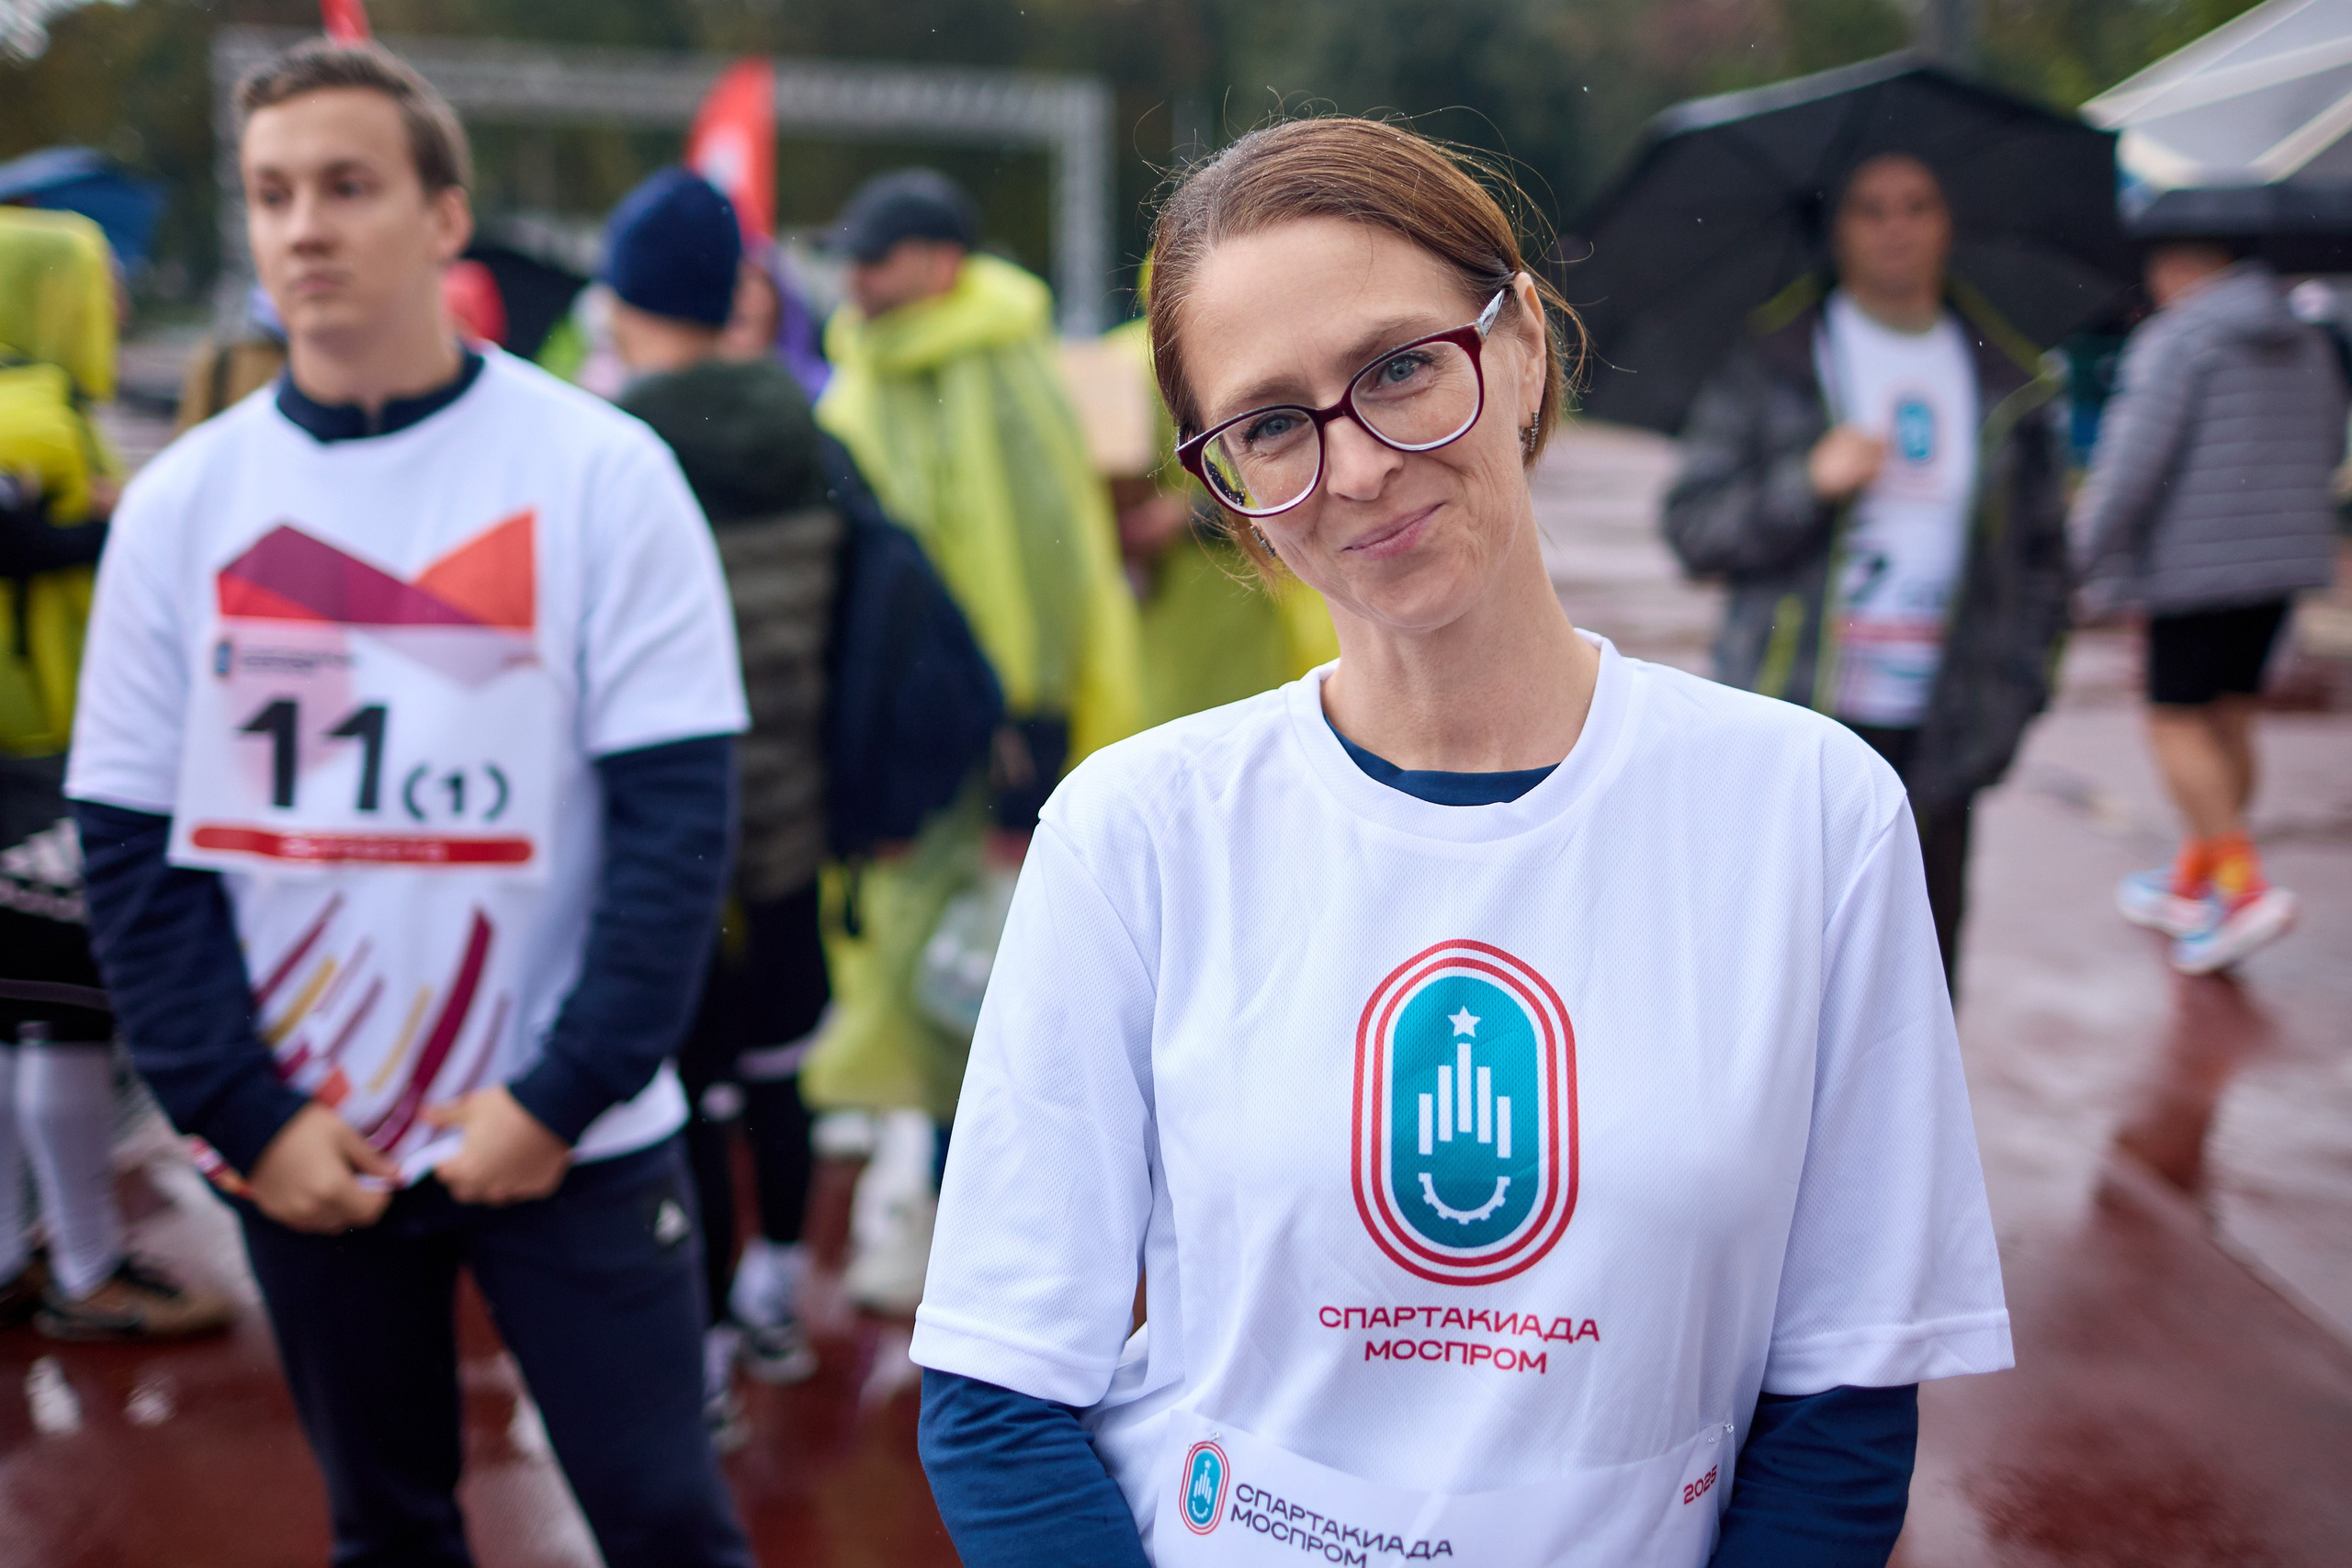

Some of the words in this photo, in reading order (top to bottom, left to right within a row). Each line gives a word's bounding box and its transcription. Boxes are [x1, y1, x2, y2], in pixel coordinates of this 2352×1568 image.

[1318, 1305, 1600, 1344] СПАРТАКИАДА
[1364, 1338, 1547, 1374] МОСПРОМ
[1683, 1463, 1718, 1506] 2025
[1230, 1504, 1368, 1568] МОСПРОМ
[1236, 1483, 1453, 1560] СПАРТАКИАДА
